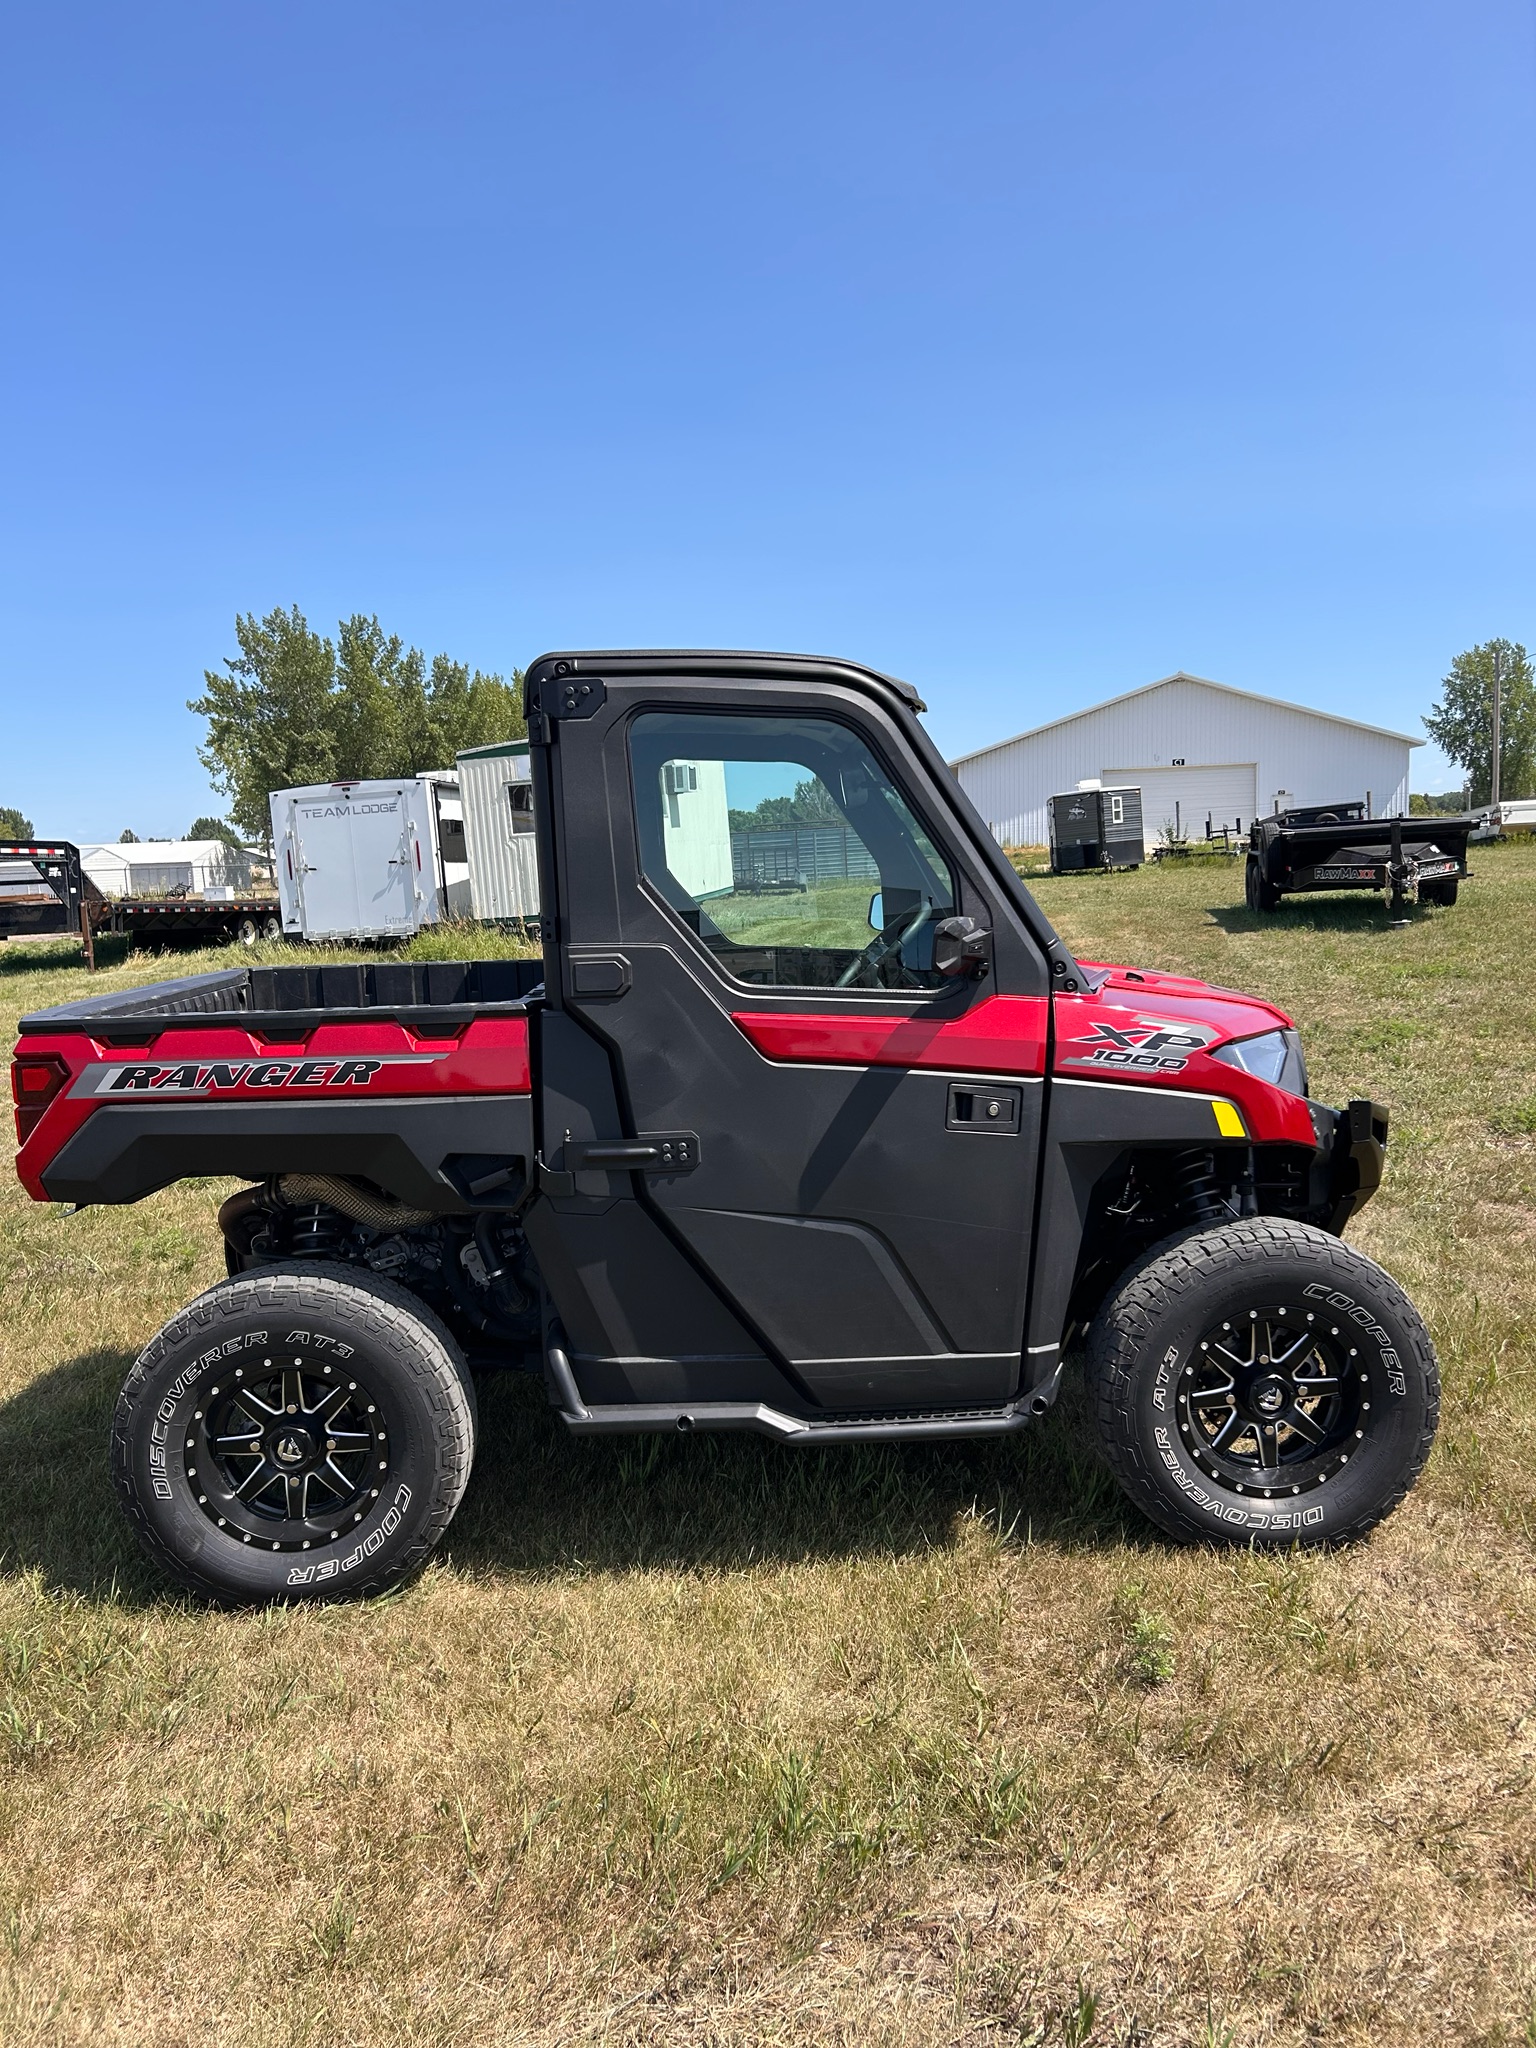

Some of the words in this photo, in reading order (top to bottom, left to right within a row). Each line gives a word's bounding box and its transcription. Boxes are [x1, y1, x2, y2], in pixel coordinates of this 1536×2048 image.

[1066, 1022, 1208, 1051] XP
[1092, 1049, 1188, 1070] 1000
[1113, 1064, 1159, 1073] OVERHEAD
[109, 1060, 382, 1090] RANGER
[1303, 1283, 1406, 1396] COOPER
[1153, 1345, 1179, 1411] AT3
[149, 1331, 269, 1500] DISCOVERER
[286, 1330, 354, 1359] AT3
[1154, 1427, 1323, 1530] DISCOVERER
[287, 1484, 412, 1586] COOPER
